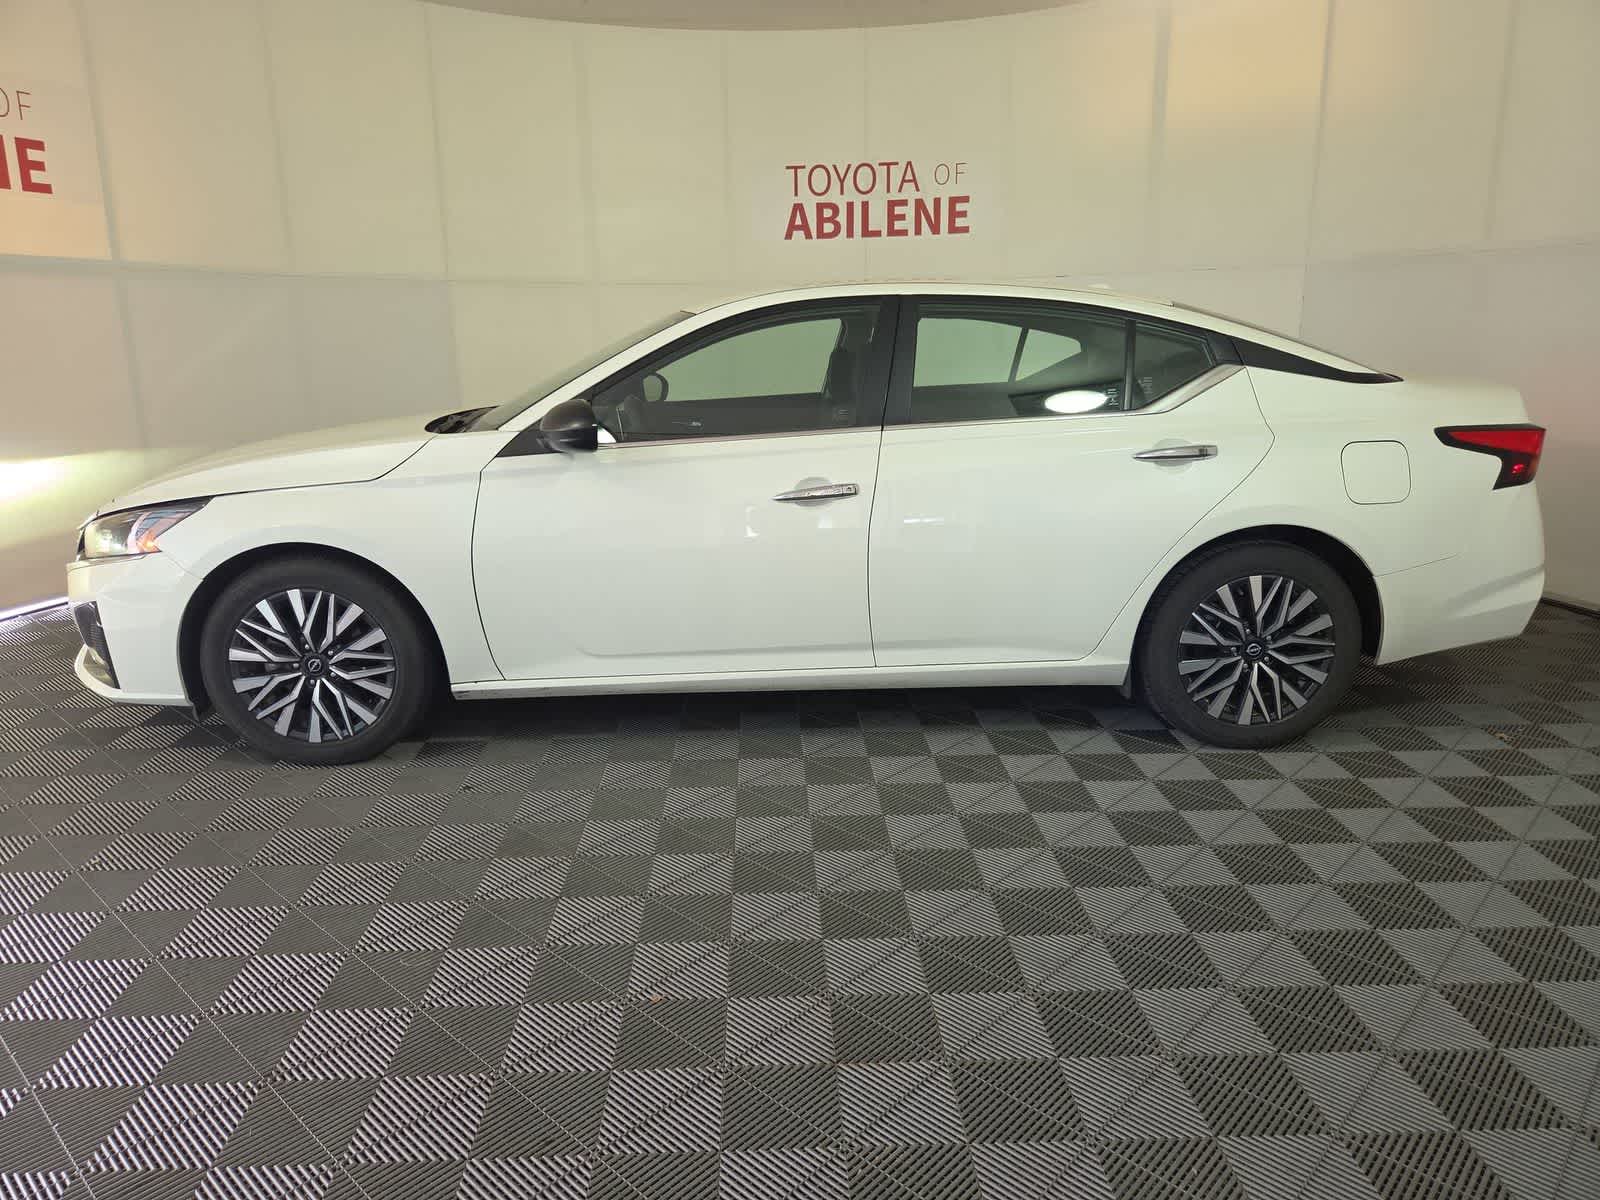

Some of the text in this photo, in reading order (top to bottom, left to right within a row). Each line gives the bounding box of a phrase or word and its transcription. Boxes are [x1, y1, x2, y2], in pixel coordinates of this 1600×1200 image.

[785, 160, 968, 197] TOYOTA OF
[784, 195, 970, 240] ABILENE
